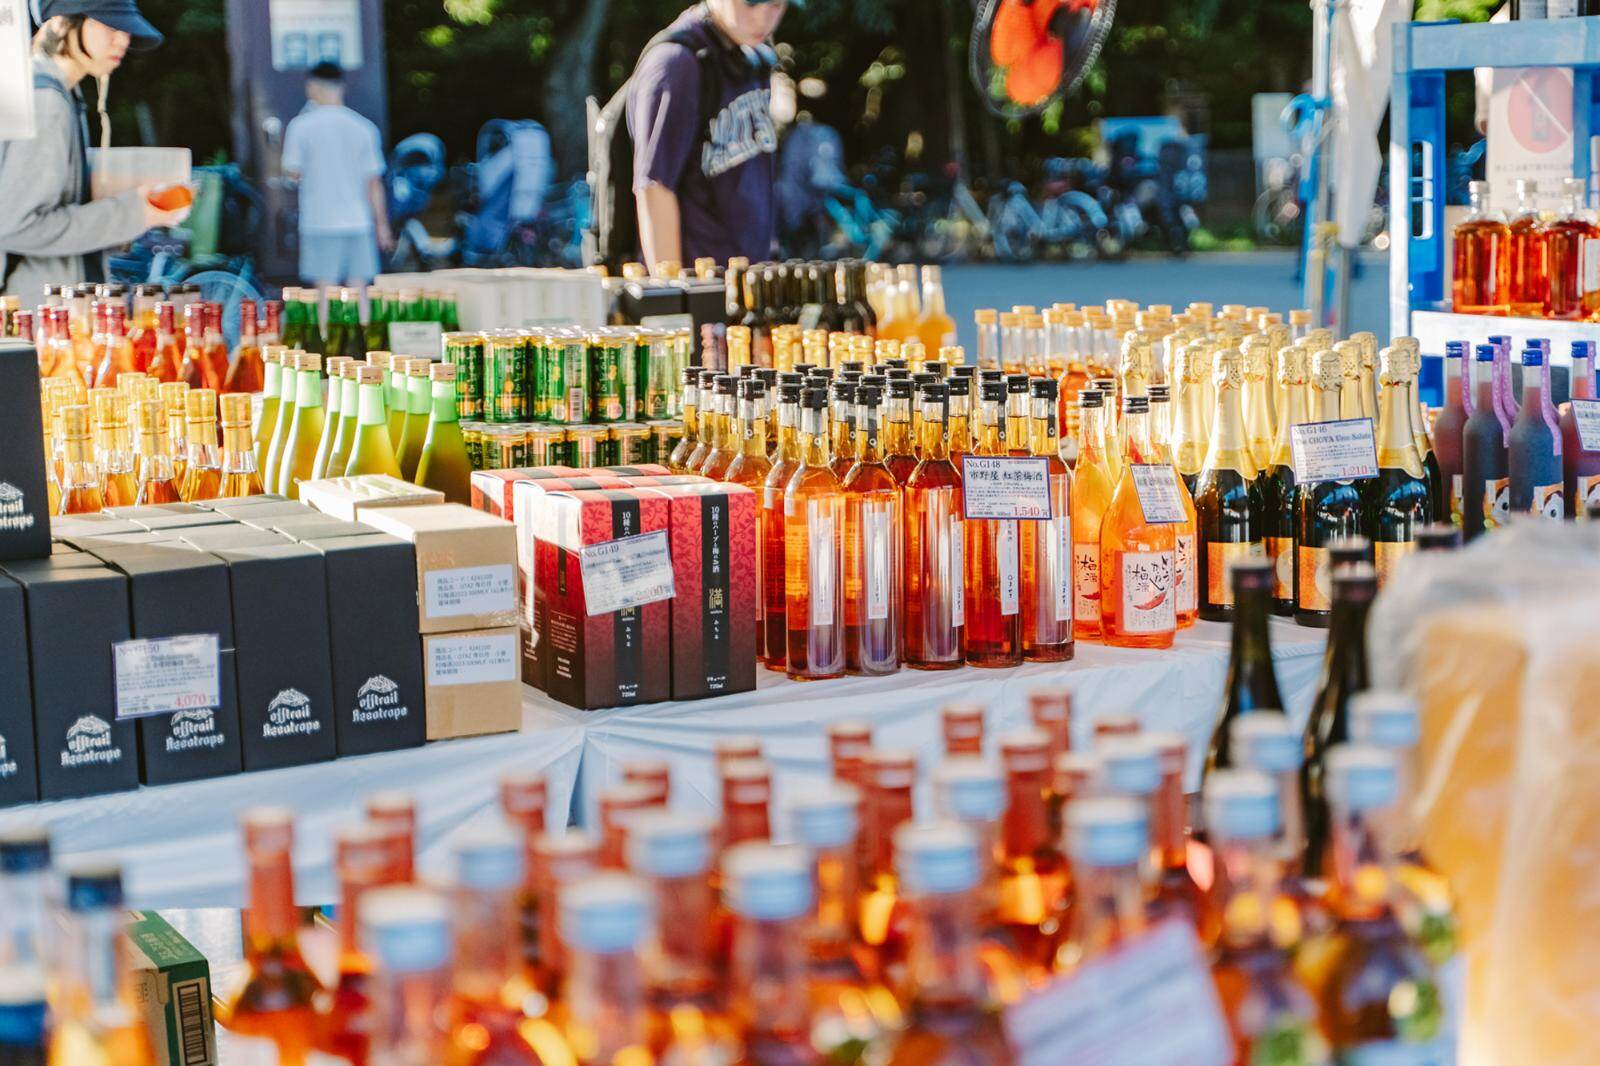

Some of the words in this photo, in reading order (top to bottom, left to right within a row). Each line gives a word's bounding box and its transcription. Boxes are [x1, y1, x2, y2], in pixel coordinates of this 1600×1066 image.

[1308, 436, 1334, 444] CHOYA
[966, 460, 1000, 468] No.G148
[970, 471, 999, 481] 市野屋
[1003, 471, 1042, 481] 紅茶梅酒
[1014, 507, 1040, 516] 1,540
[0, 514, 34, 531] trope
[176, 694, 206, 708] 4,070
[359, 691, 398, 710] offtrail
[270, 705, 310, 724] offtrail
[173, 719, 215, 738] offtrail
[68, 732, 111, 752] offtrail
